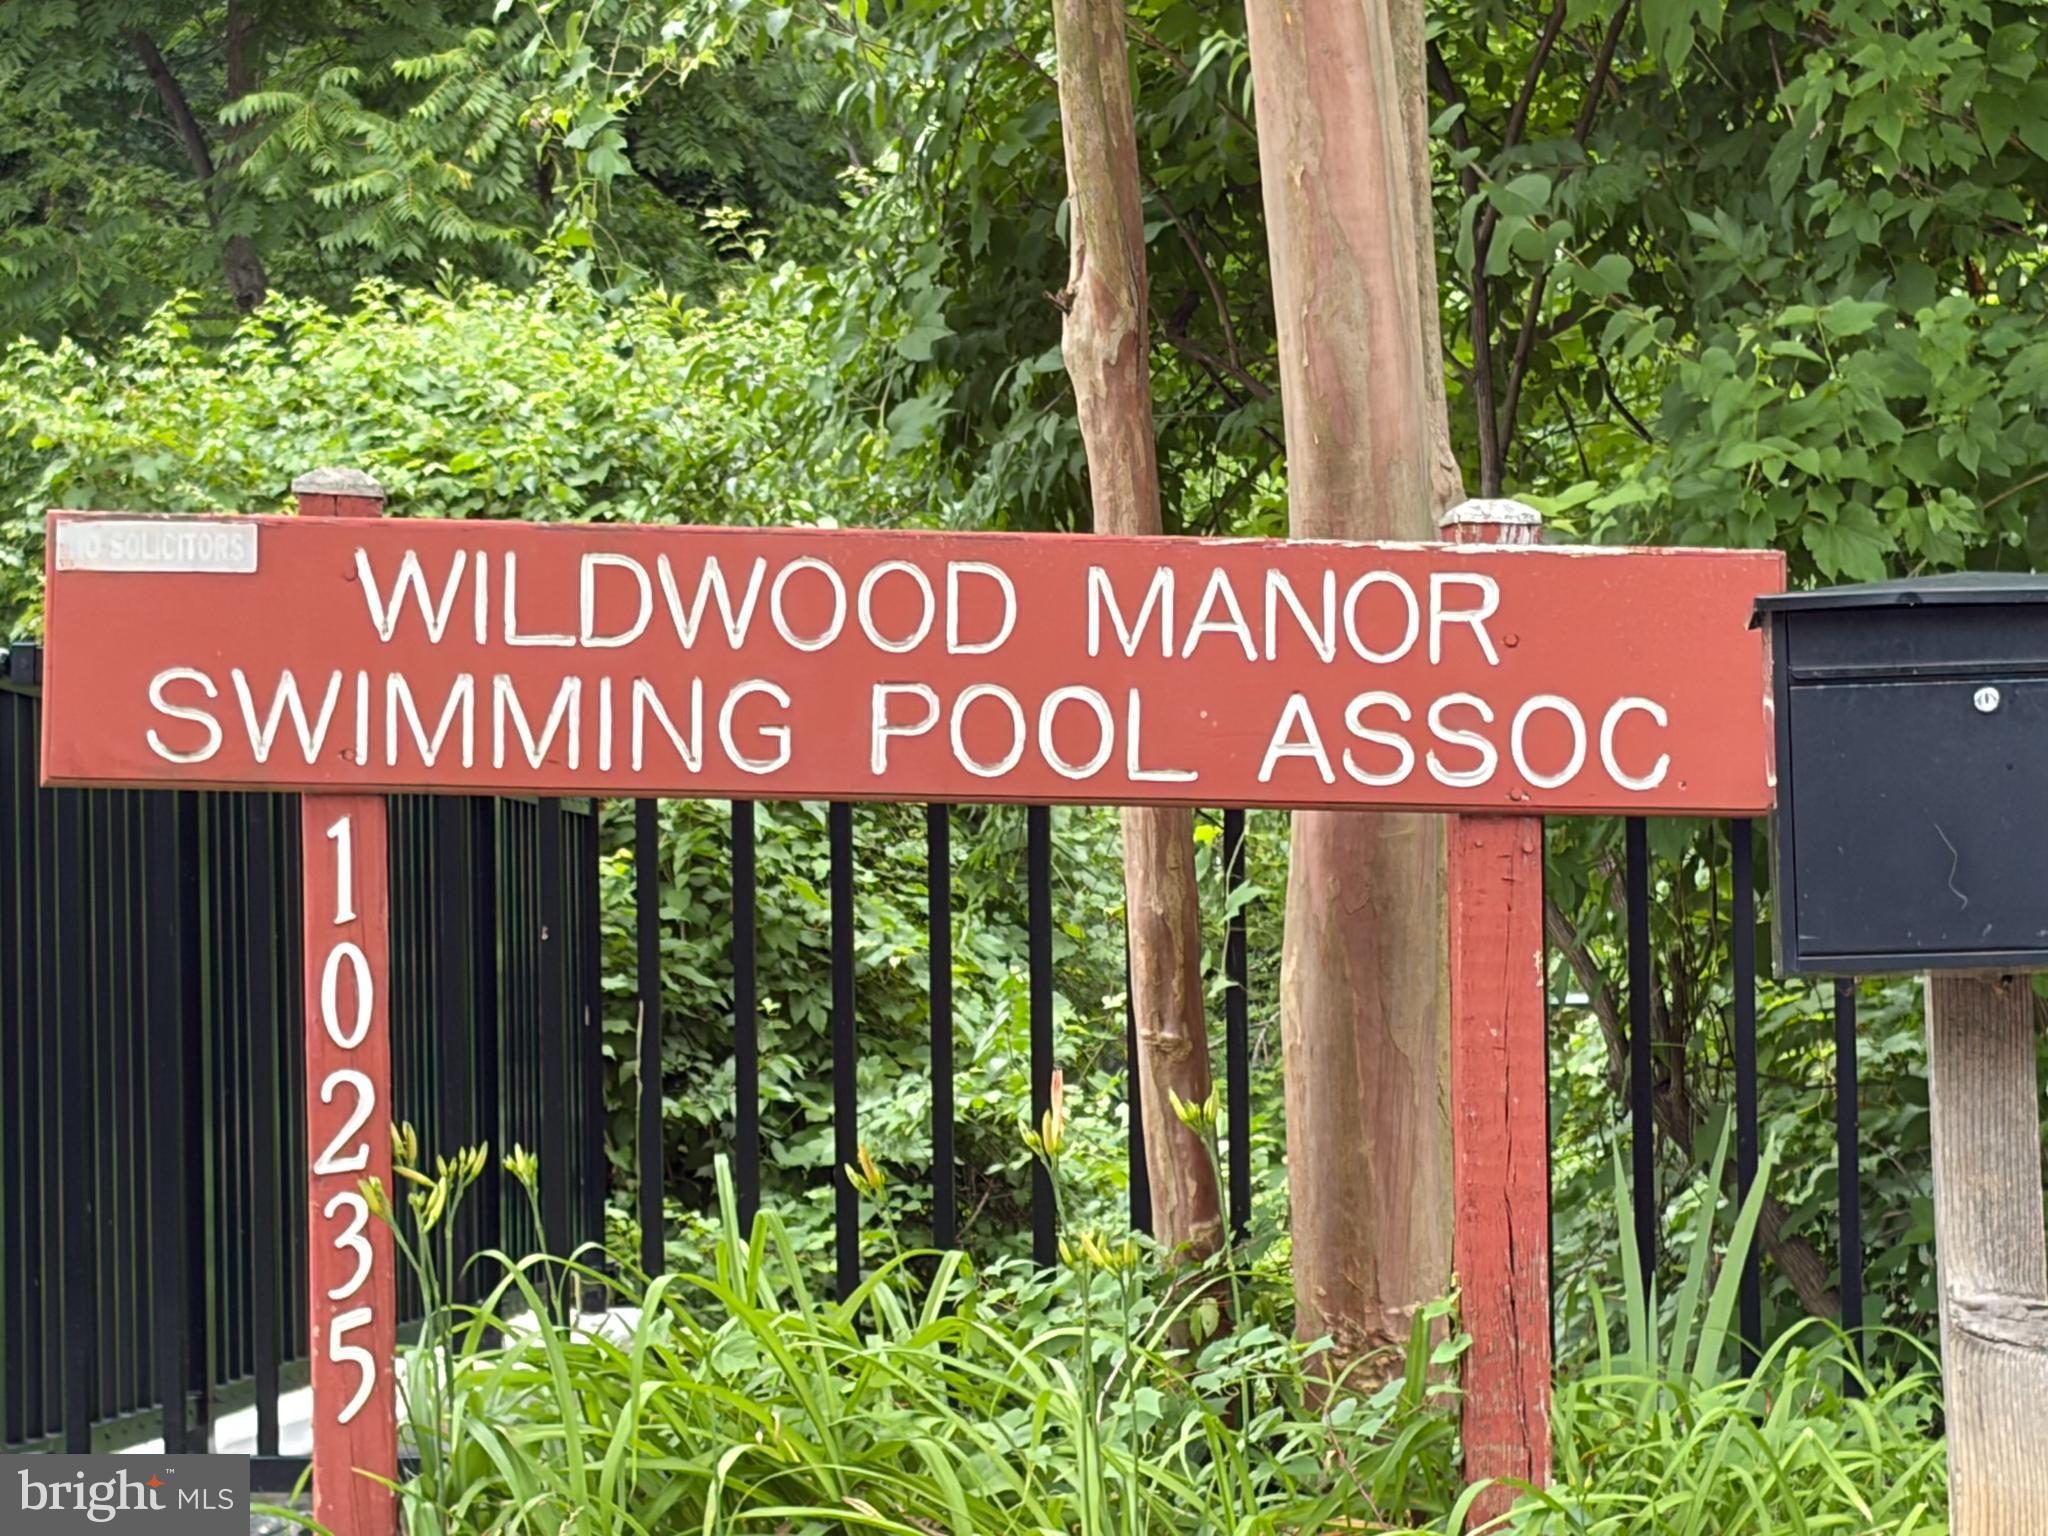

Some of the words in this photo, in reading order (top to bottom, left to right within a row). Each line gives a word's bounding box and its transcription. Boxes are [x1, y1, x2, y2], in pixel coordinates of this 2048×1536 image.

[109, 530, 245, 561] SOLICITORS
[354, 547, 1017, 655] WILDWOOD
[1087, 566, 1500, 666] MANOR
[146, 667, 791, 775] SWIMMING
[870, 683, 1199, 782] POOL
[1257, 693, 1671, 791] ASSOC
[312, 816, 377, 1425] 10235
